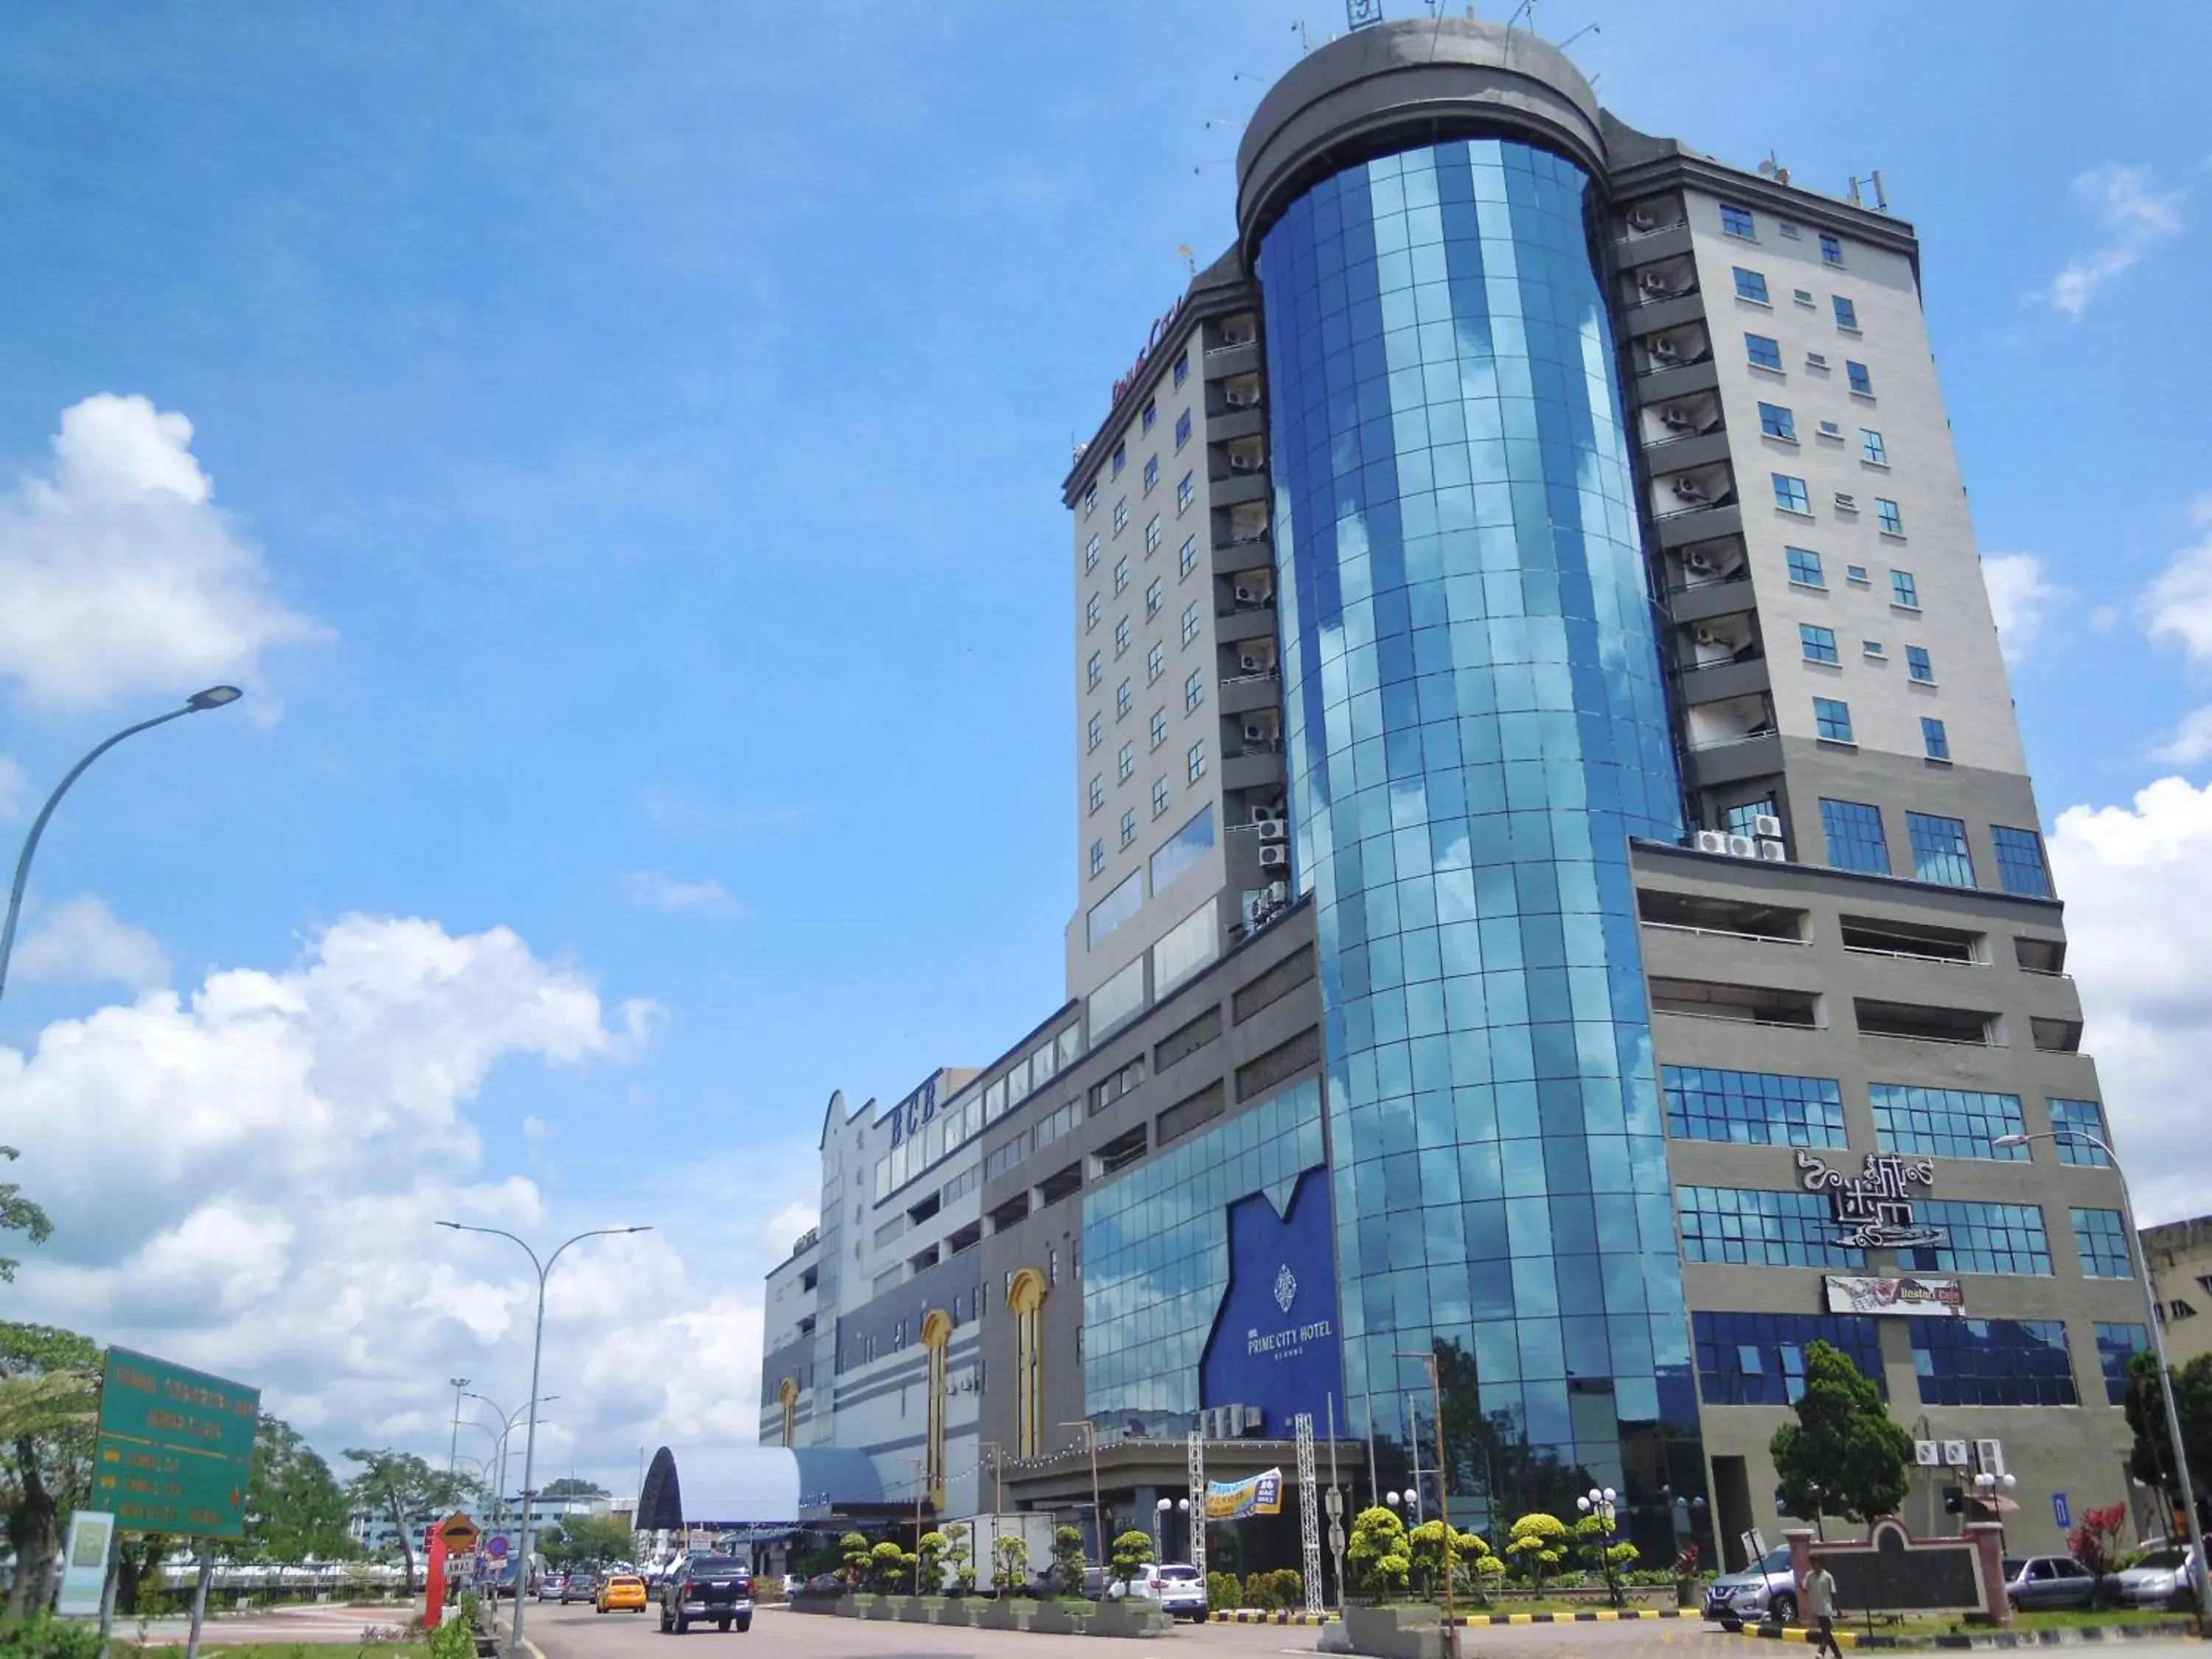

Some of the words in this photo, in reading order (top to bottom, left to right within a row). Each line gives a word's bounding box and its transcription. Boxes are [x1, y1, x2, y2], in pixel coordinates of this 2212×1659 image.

[891, 1079, 936, 1149] BCB
[1248, 1335, 1275, 1356] PRIME
[1276, 1329, 1297, 1348] CITY
[1300, 1321, 1332, 1342] HOTEL
[449, 1562, 469, 1572] AWAS
